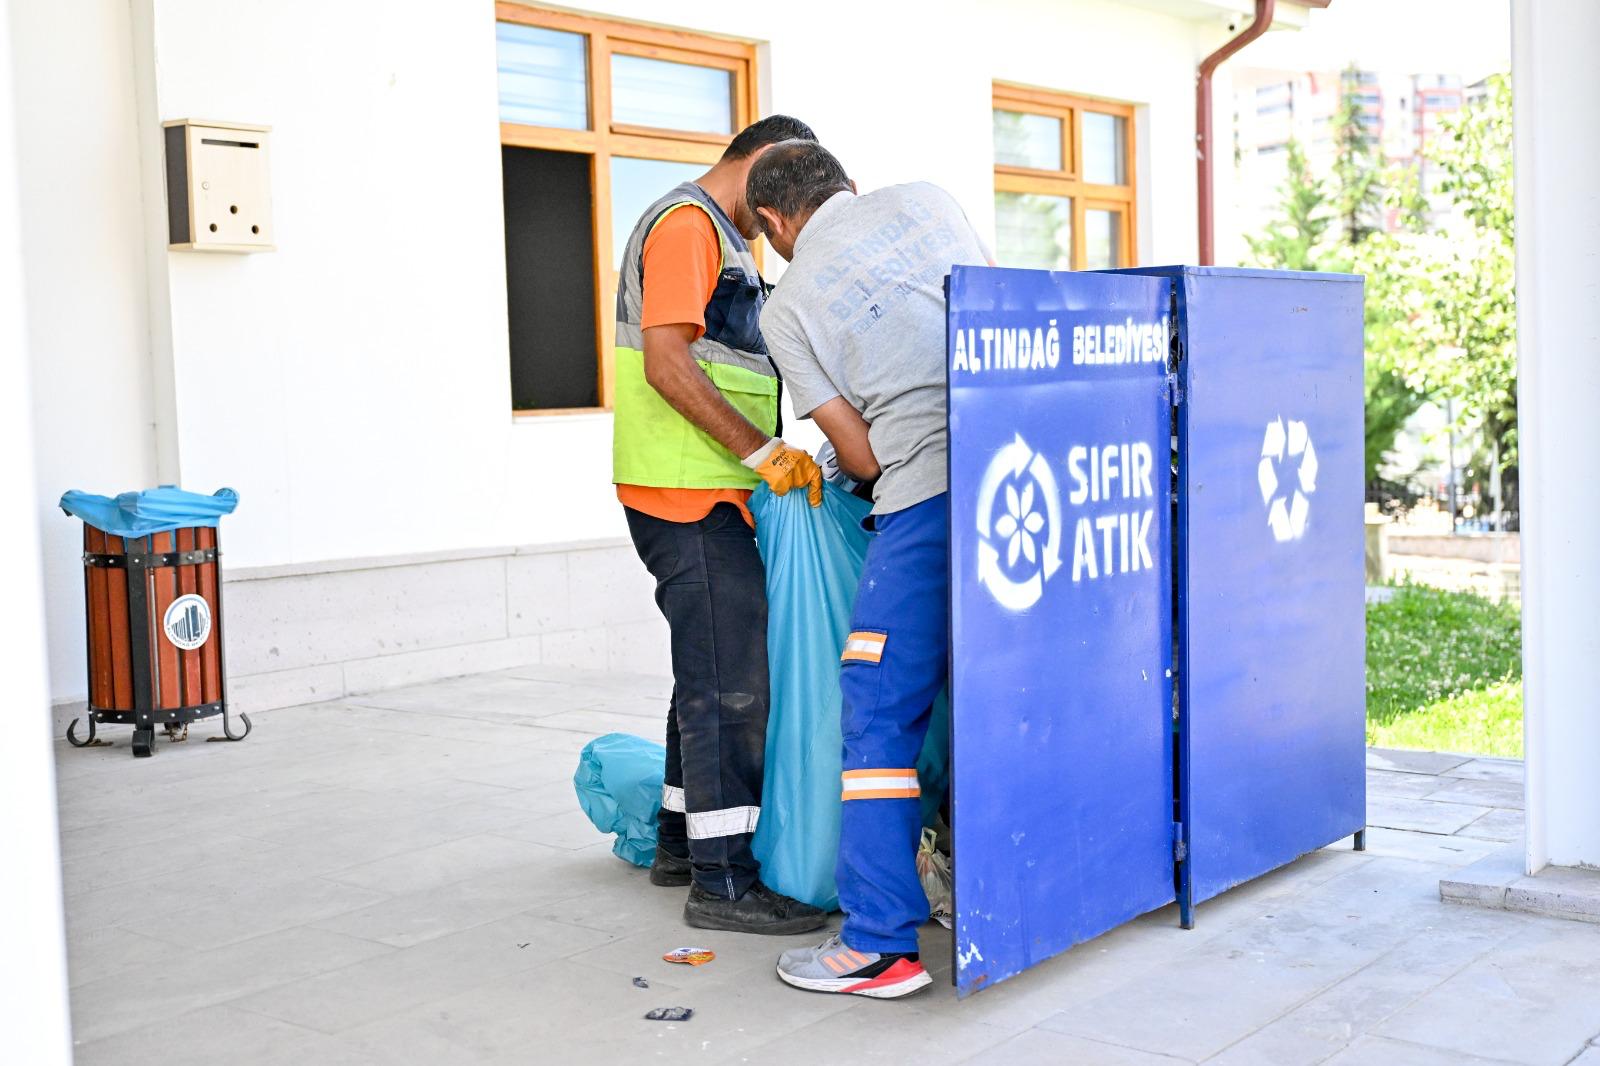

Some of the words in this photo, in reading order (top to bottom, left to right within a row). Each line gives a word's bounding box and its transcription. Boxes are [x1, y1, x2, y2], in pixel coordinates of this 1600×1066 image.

[952, 319, 1060, 372] ALTINDAĞ
[1072, 316, 1169, 365] BELEDİYESİ
[1068, 442, 1153, 505] SIFIR
[1072, 510, 1154, 582] ATIK
